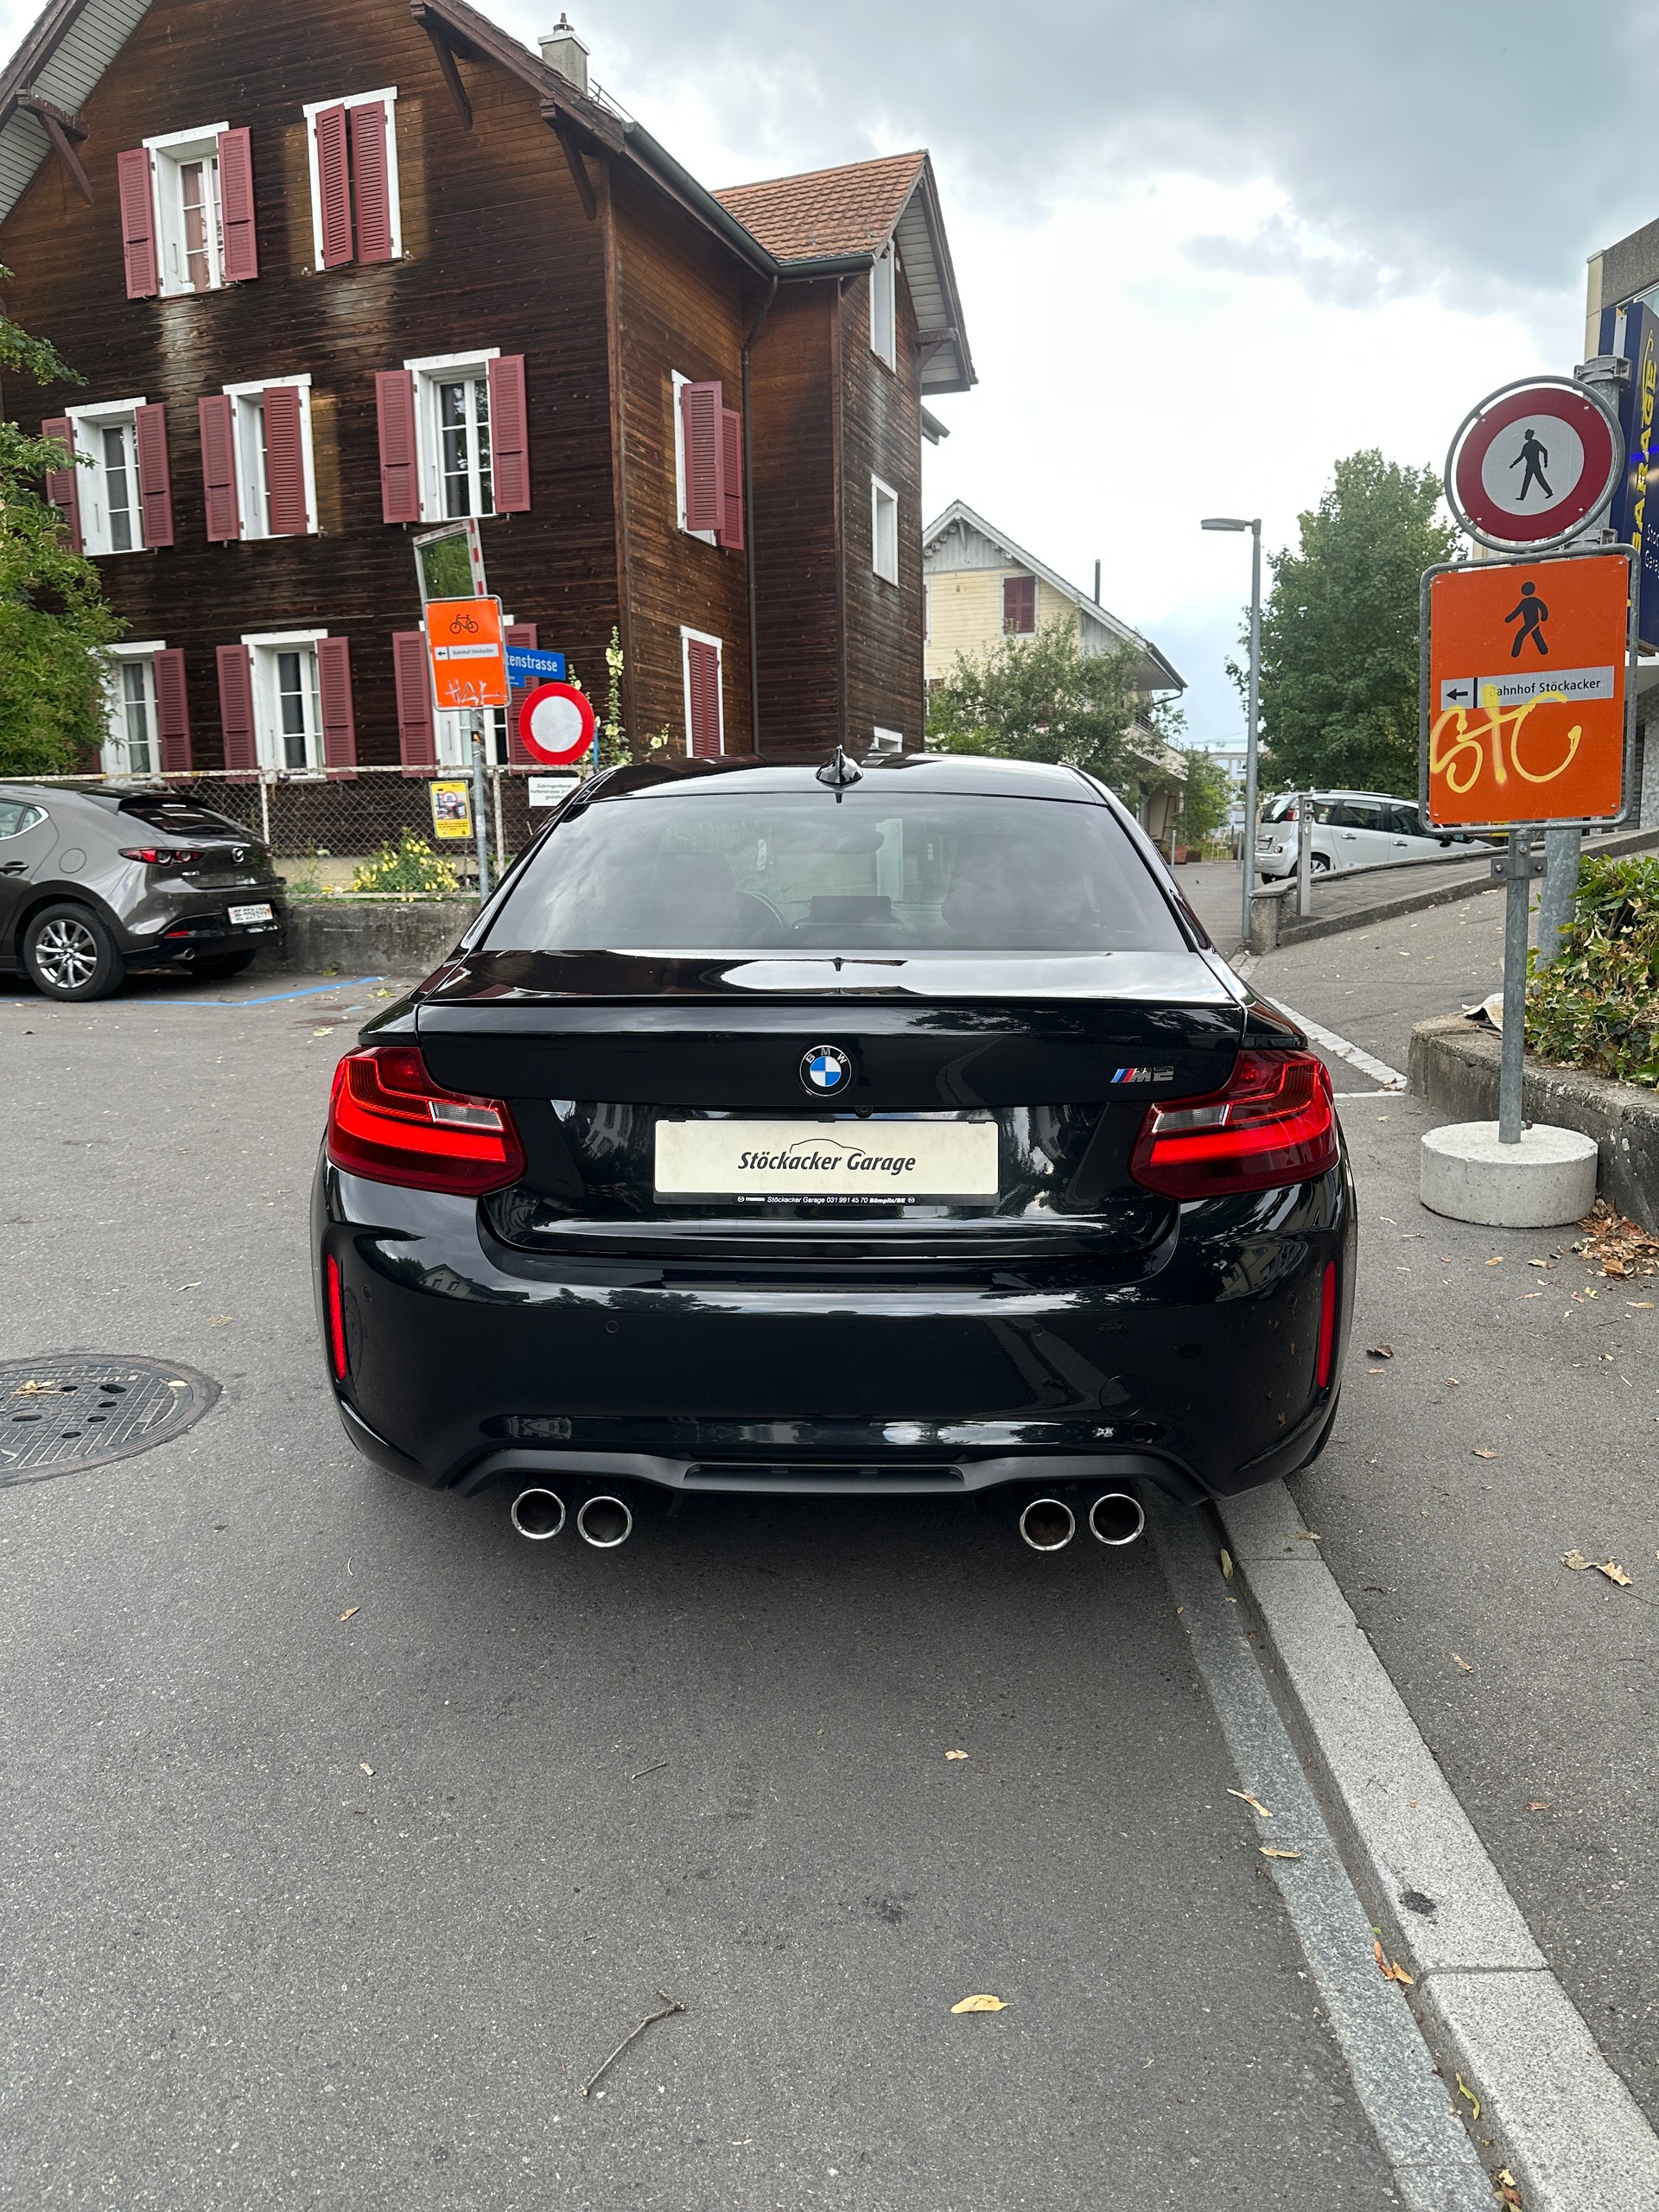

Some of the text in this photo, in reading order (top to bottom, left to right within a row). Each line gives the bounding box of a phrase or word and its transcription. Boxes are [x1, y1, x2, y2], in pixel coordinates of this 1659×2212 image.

[1539, 678, 1601, 693] Stöckacker
[804, 1047, 847, 1064] BMW
[1127, 1065, 1174, 1083] M2
[738, 1151, 916, 1175] Stöckacker Garage
